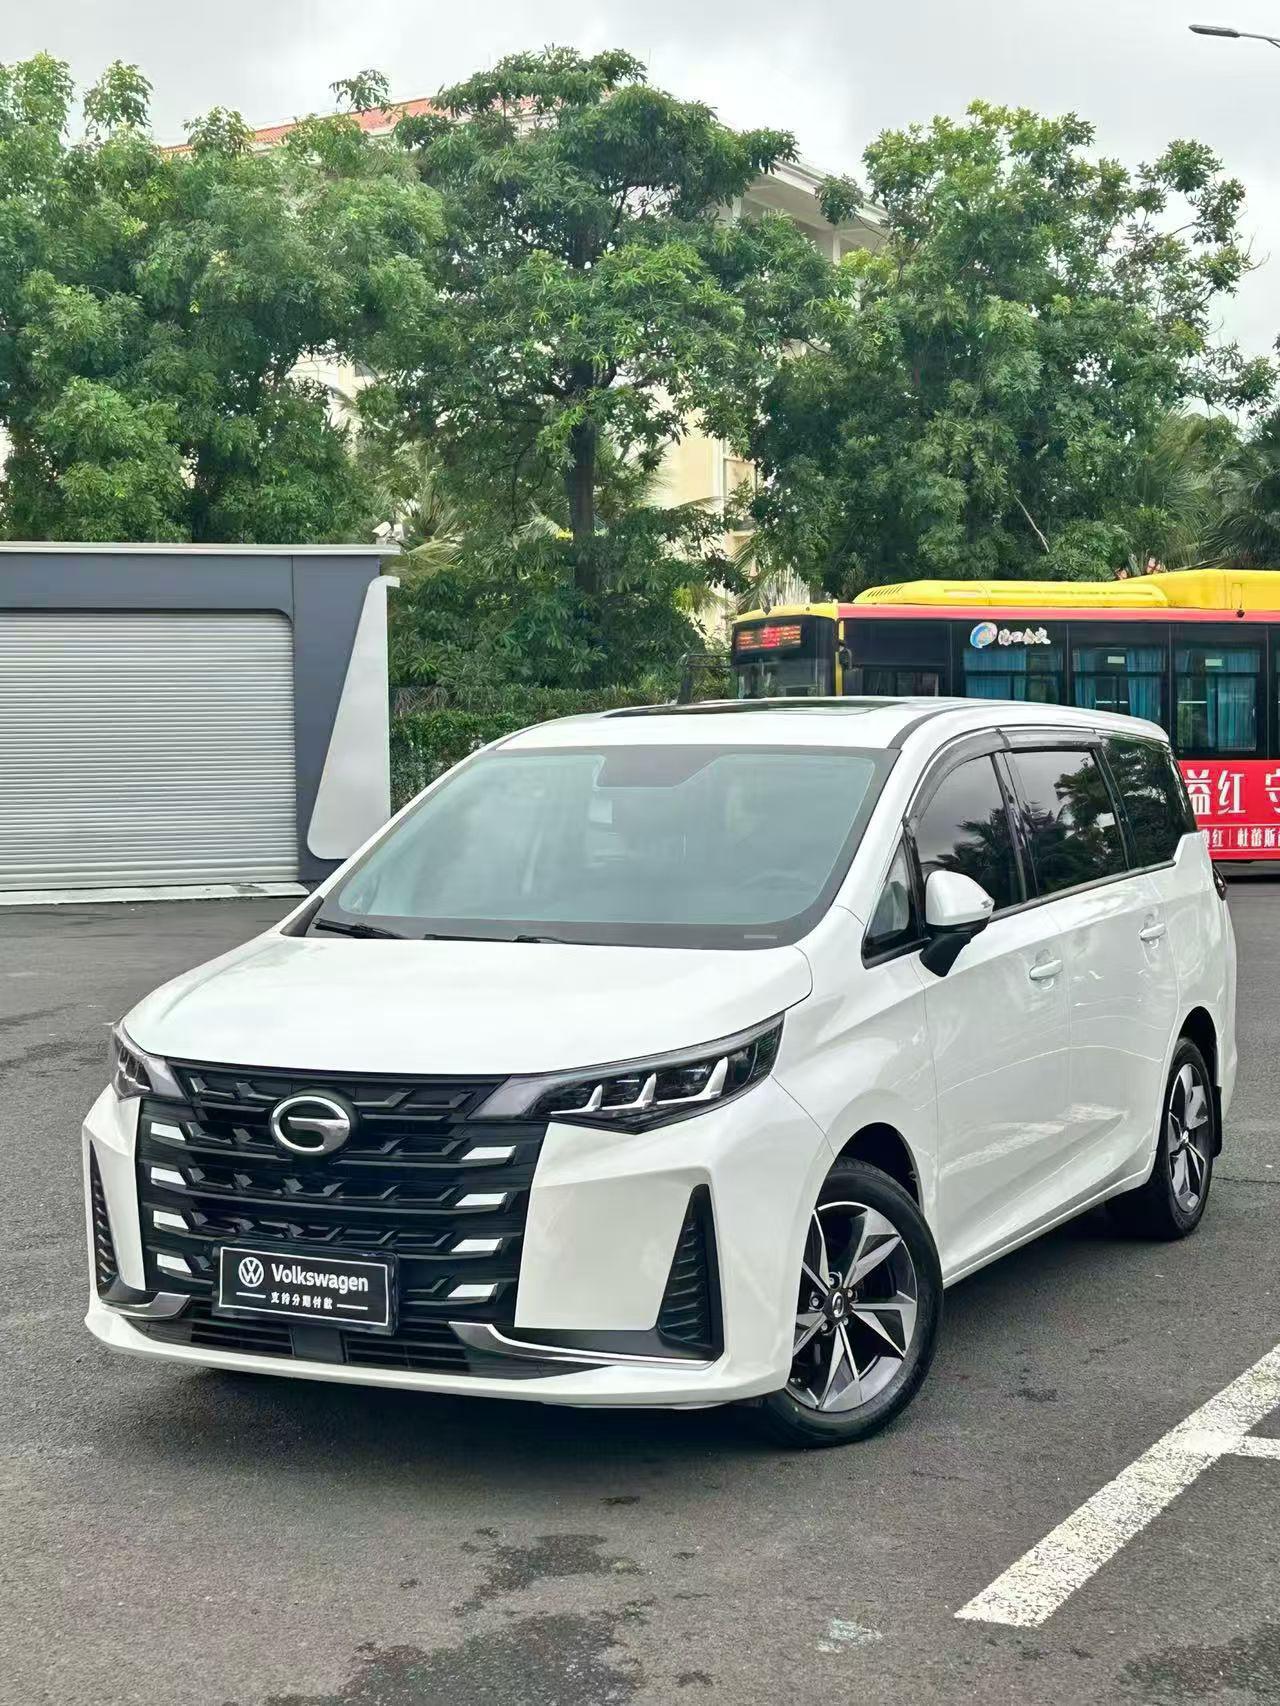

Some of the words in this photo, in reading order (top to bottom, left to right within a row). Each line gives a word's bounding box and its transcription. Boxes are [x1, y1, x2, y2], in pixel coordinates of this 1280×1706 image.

[1237, 827, 1280, 848] 杜蕾斯
[271, 1263, 369, 1294] Volkswagen
